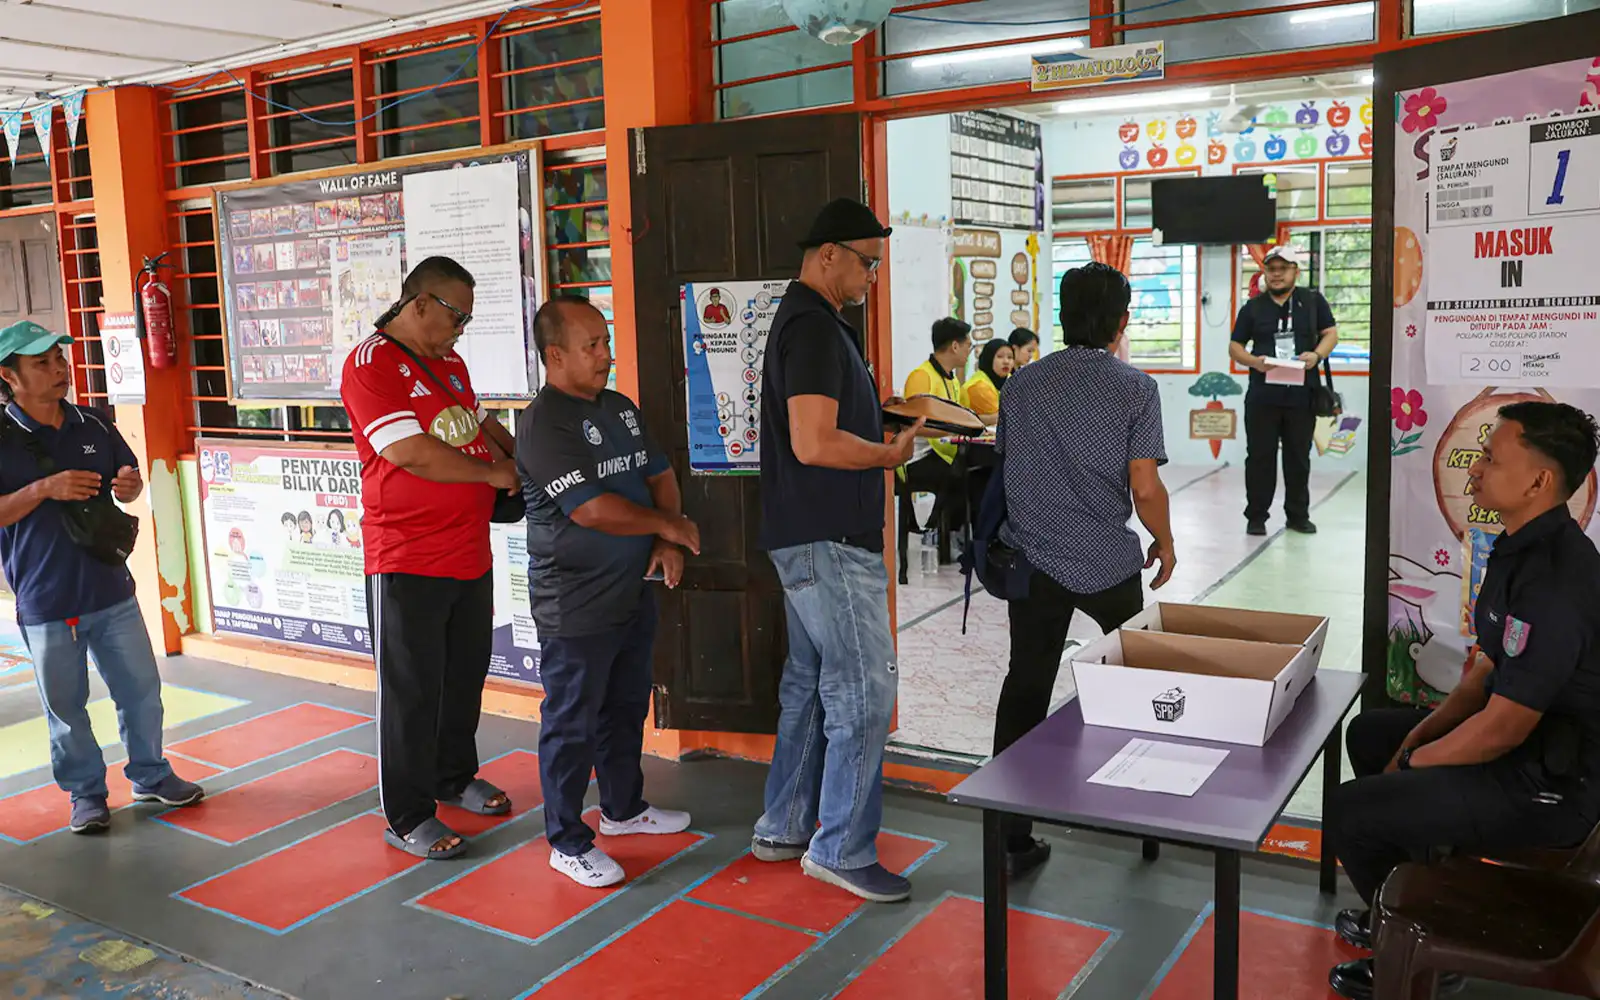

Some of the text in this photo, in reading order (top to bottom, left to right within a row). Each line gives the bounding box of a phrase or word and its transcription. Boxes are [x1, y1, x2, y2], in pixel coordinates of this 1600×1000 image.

[1545, 128, 1586, 140] SALURAN
[1548, 120, 1590, 132] NOMBOR
[1437, 158, 1509, 172] TEMPAT MENGUNDI
[319, 172, 397, 194] WALL OF FAME
[1546, 150, 1571, 205] 1
[1474, 226, 1553, 259] MASUK
[1501, 260, 1523, 288] IN
[1505, 298, 1540, 307] TEMPAT
[1434, 314, 1486, 323] PENGUNDIAN
[1532, 312, 1580, 321] MENGUNDI
[281, 458, 362, 478] PENTAKSI
[282, 475, 322, 493] BILIK
[328, 477, 361, 494] DAR
[545, 469, 586, 499] KOME
[1468, 502, 1504, 524] SEK
